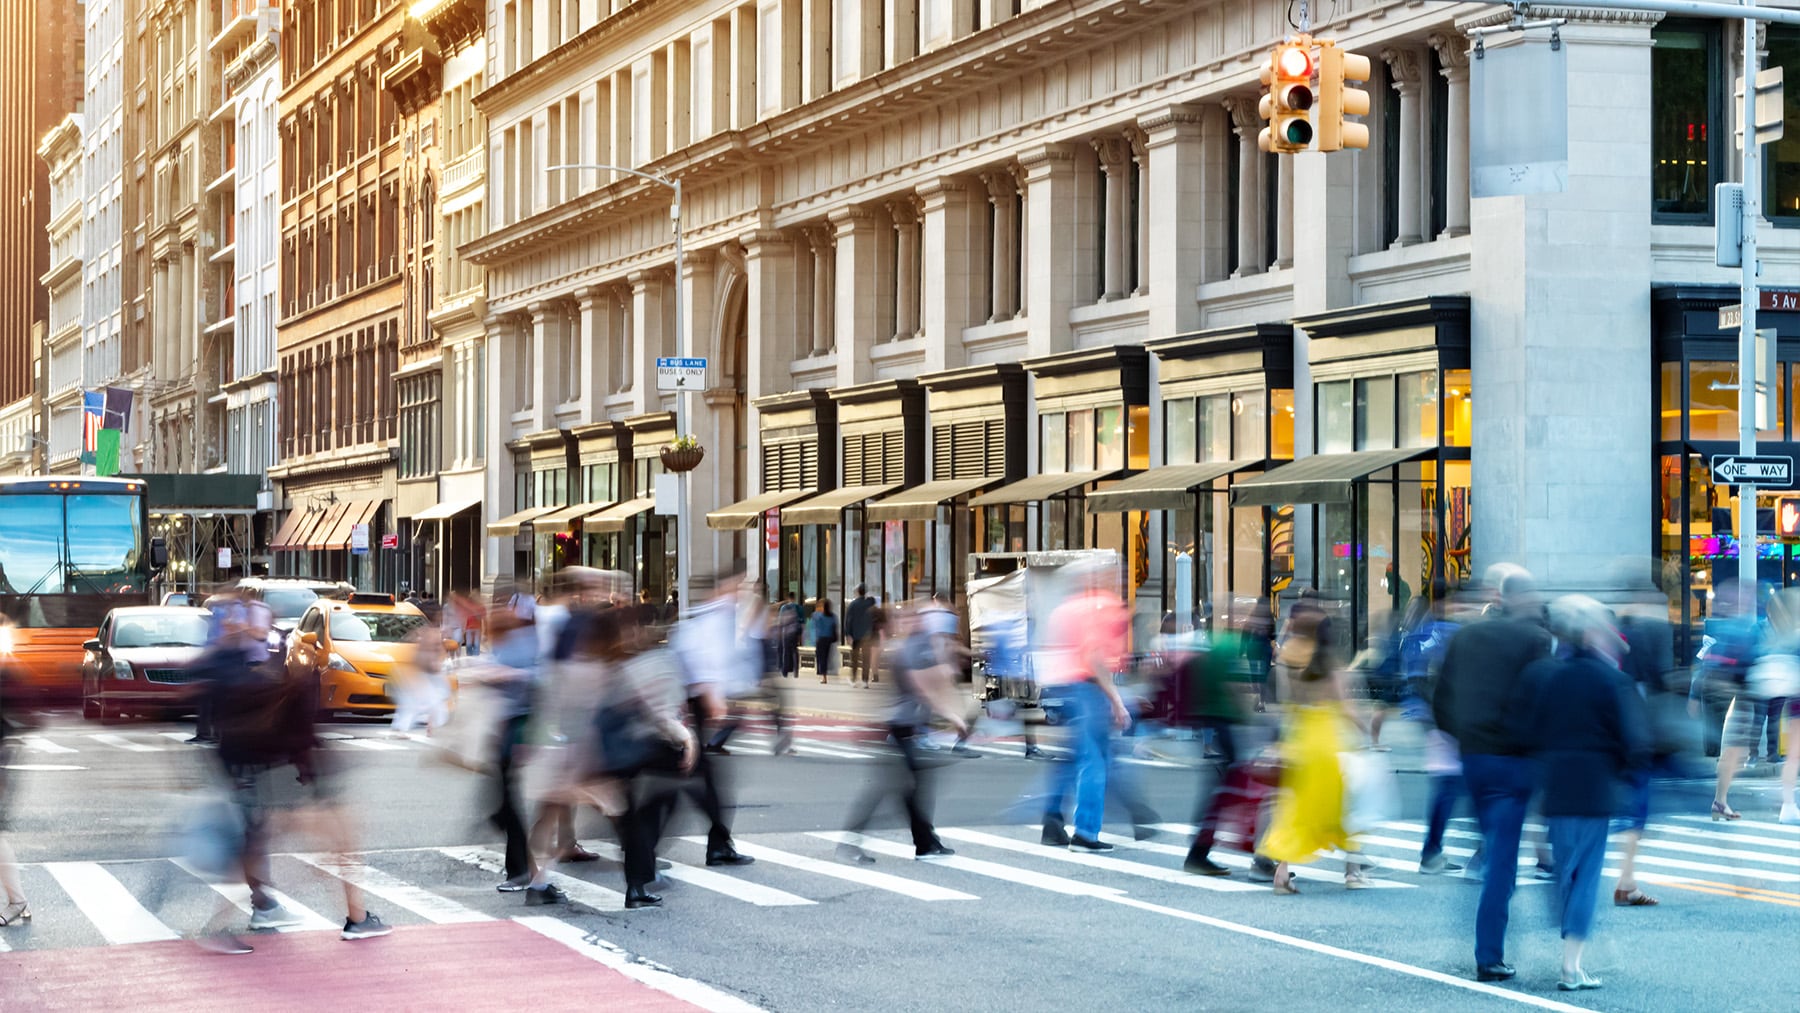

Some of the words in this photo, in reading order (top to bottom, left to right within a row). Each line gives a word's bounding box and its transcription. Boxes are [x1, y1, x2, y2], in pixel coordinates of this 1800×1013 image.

[1772, 294, 1778, 308] 5
[1783, 294, 1796, 309] Av
[1723, 464, 1747, 476] ONE
[1760, 465, 1785, 476] WAY
